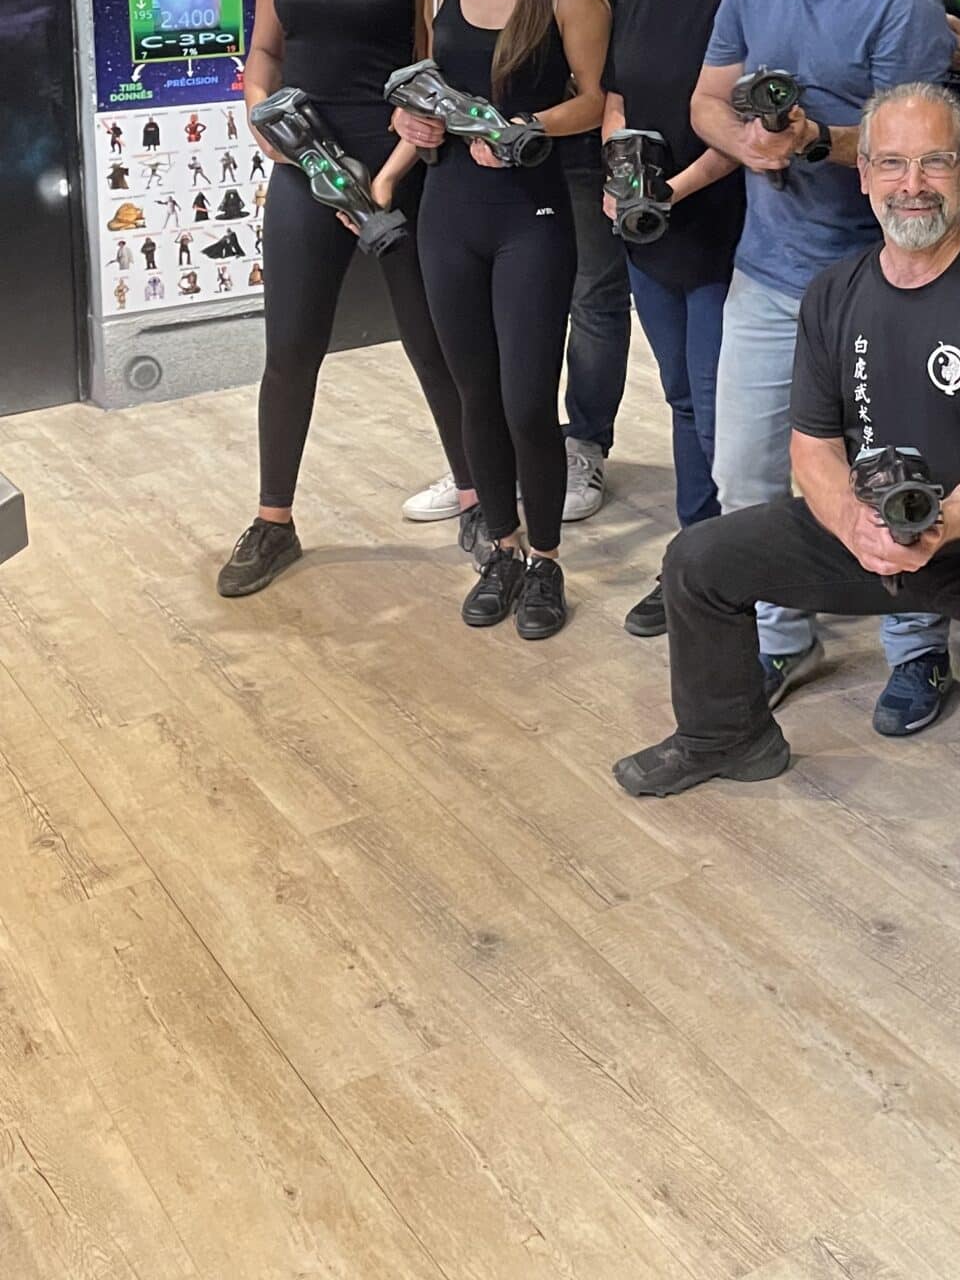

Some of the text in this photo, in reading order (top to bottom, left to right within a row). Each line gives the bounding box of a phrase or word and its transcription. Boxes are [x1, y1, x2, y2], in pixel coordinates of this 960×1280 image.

[133, 10, 153, 21] 195
[160, 8, 216, 29] 2.400
[119, 82, 143, 92] TIRS
[166, 75, 219, 88] PRÉCISION
[110, 90, 154, 102] DONNÉS
